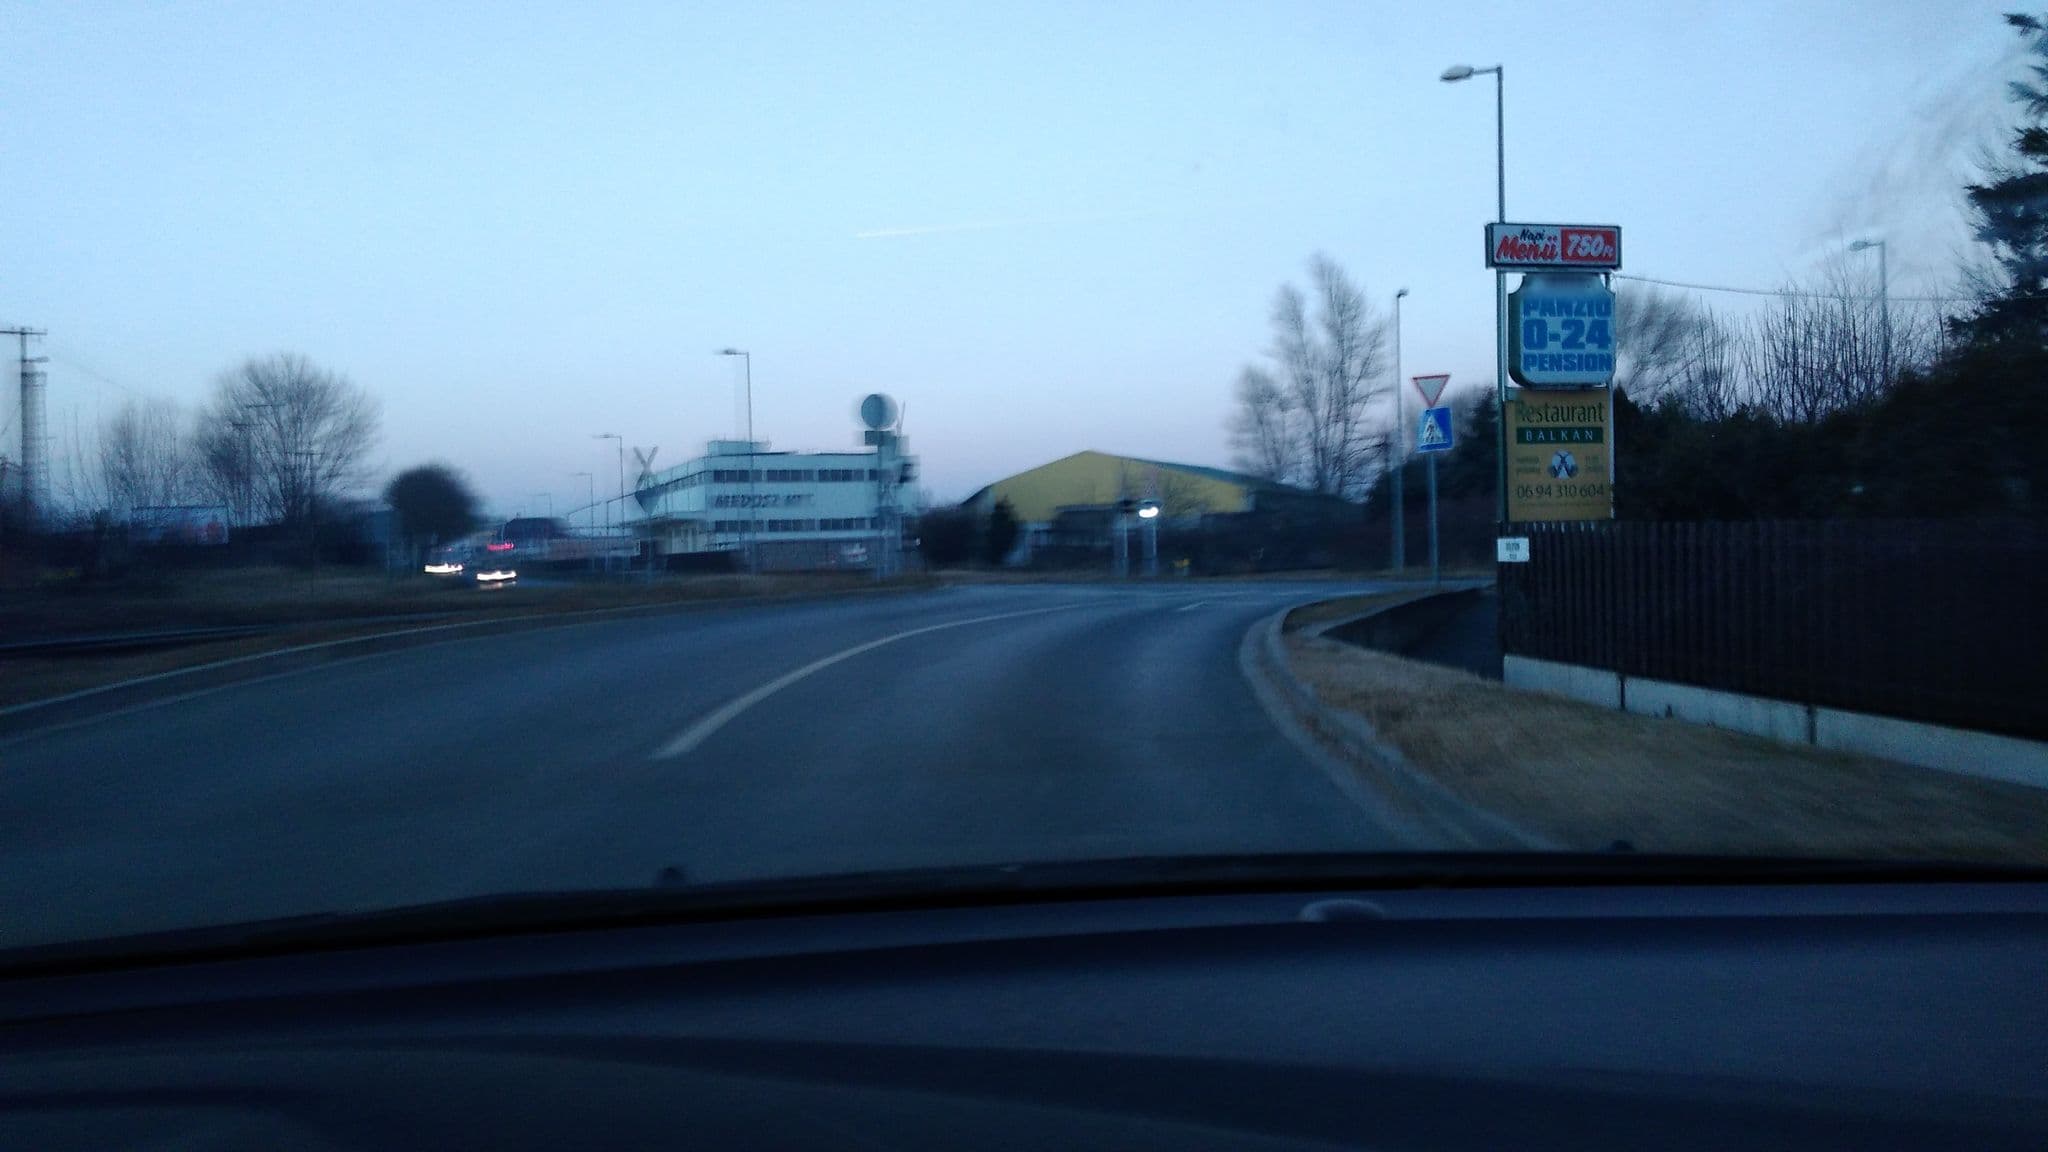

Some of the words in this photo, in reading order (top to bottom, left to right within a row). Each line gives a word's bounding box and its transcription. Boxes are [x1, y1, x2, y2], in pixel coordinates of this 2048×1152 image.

[1520, 228, 1545, 244] Napi
[1496, 235, 1558, 260] Menü
[1523, 319, 1611, 350] 0-24
[1523, 353, 1612, 371] PENSION
[1517, 401, 1605, 423] Restaurant
[1526, 430, 1593, 441] BALKAN
